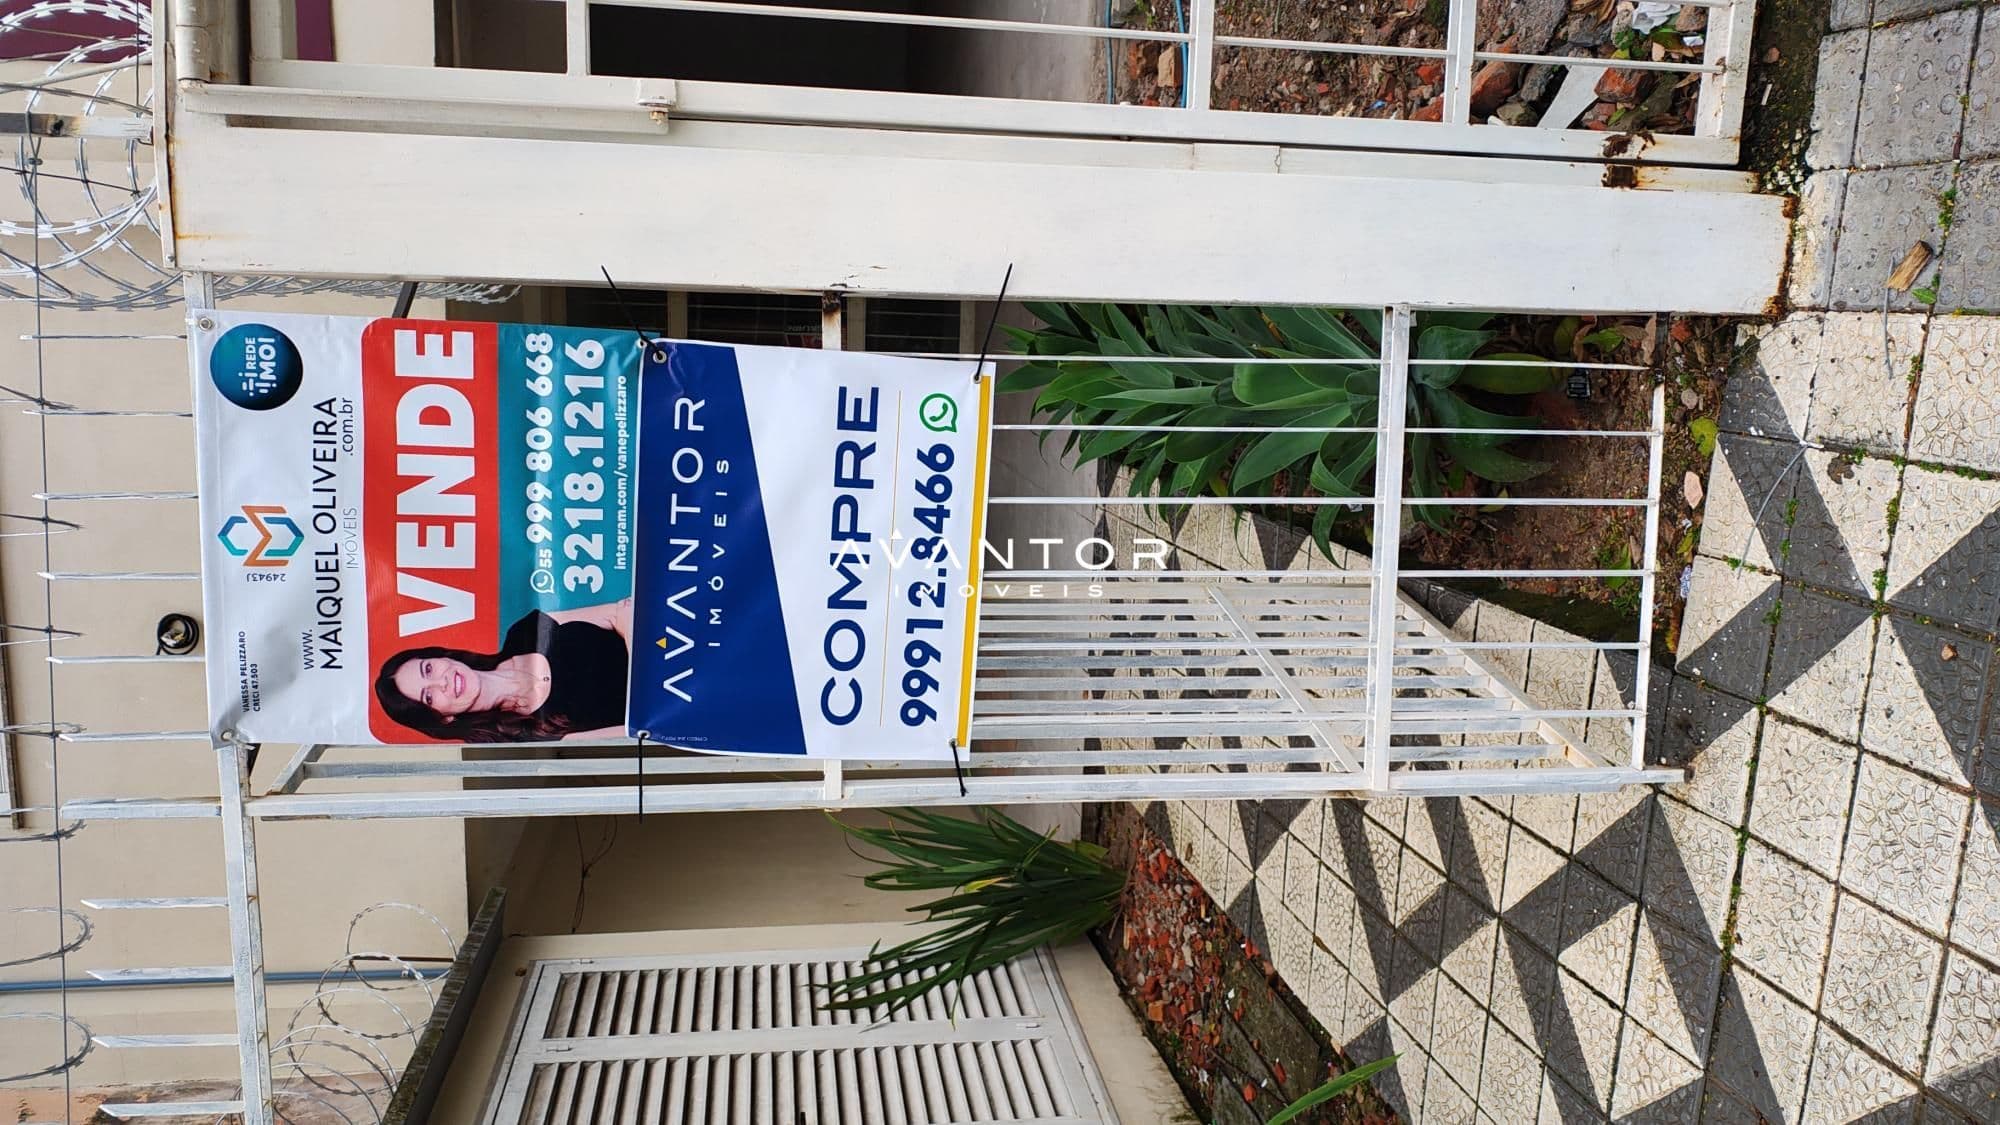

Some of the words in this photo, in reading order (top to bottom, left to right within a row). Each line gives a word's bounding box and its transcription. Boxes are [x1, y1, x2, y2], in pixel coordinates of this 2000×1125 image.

[245, 337, 256, 369] REDE
[525, 332, 554, 397] 668
[338, 398, 354, 456] .com.br
[525, 406, 553, 473] 806
[312, 397, 337, 534] OLIVEIRA
[394, 329, 477, 638] VENDE
[562, 339, 606, 594] 3218.1216
[525, 481, 553, 544] 999
[246, 573, 286, 582] 24943J
[539, 548, 552, 568] 55
[663, 397, 706, 703] AVANTOR
[707, 459, 730, 647] IMÓVEIS
[819, 385, 881, 727] COMPRE
[315, 543, 343, 670] MAIQUEL
[899, 442, 956, 728] 99912.8466
[238, 630, 248, 677] PELIZZARO
[240, 679, 250, 712] VANESSA
[251, 691, 261, 712] CRECI
